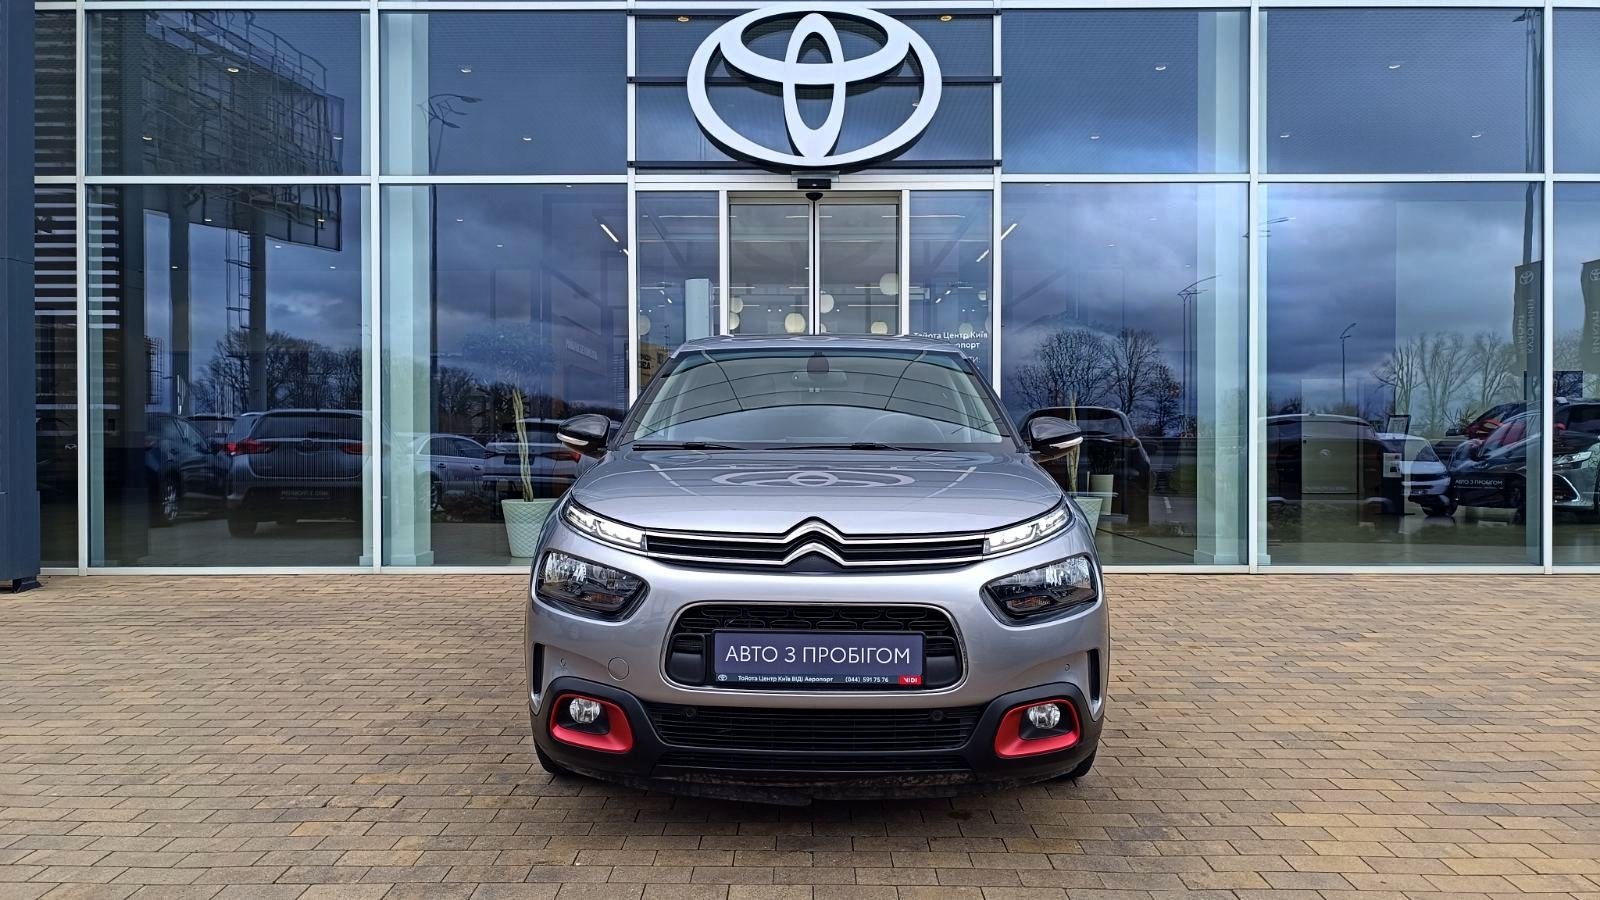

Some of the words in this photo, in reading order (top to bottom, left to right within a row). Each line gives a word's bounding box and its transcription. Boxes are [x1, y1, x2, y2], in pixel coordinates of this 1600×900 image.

[943, 331, 969, 340] Центр
[970, 330, 988, 339] Київ
[725, 645, 778, 663] АВТО
[784, 646, 796, 663] З
[803, 646, 910, 664] ПРОБІГОМ
[758, 675, 777, 683] Центр
